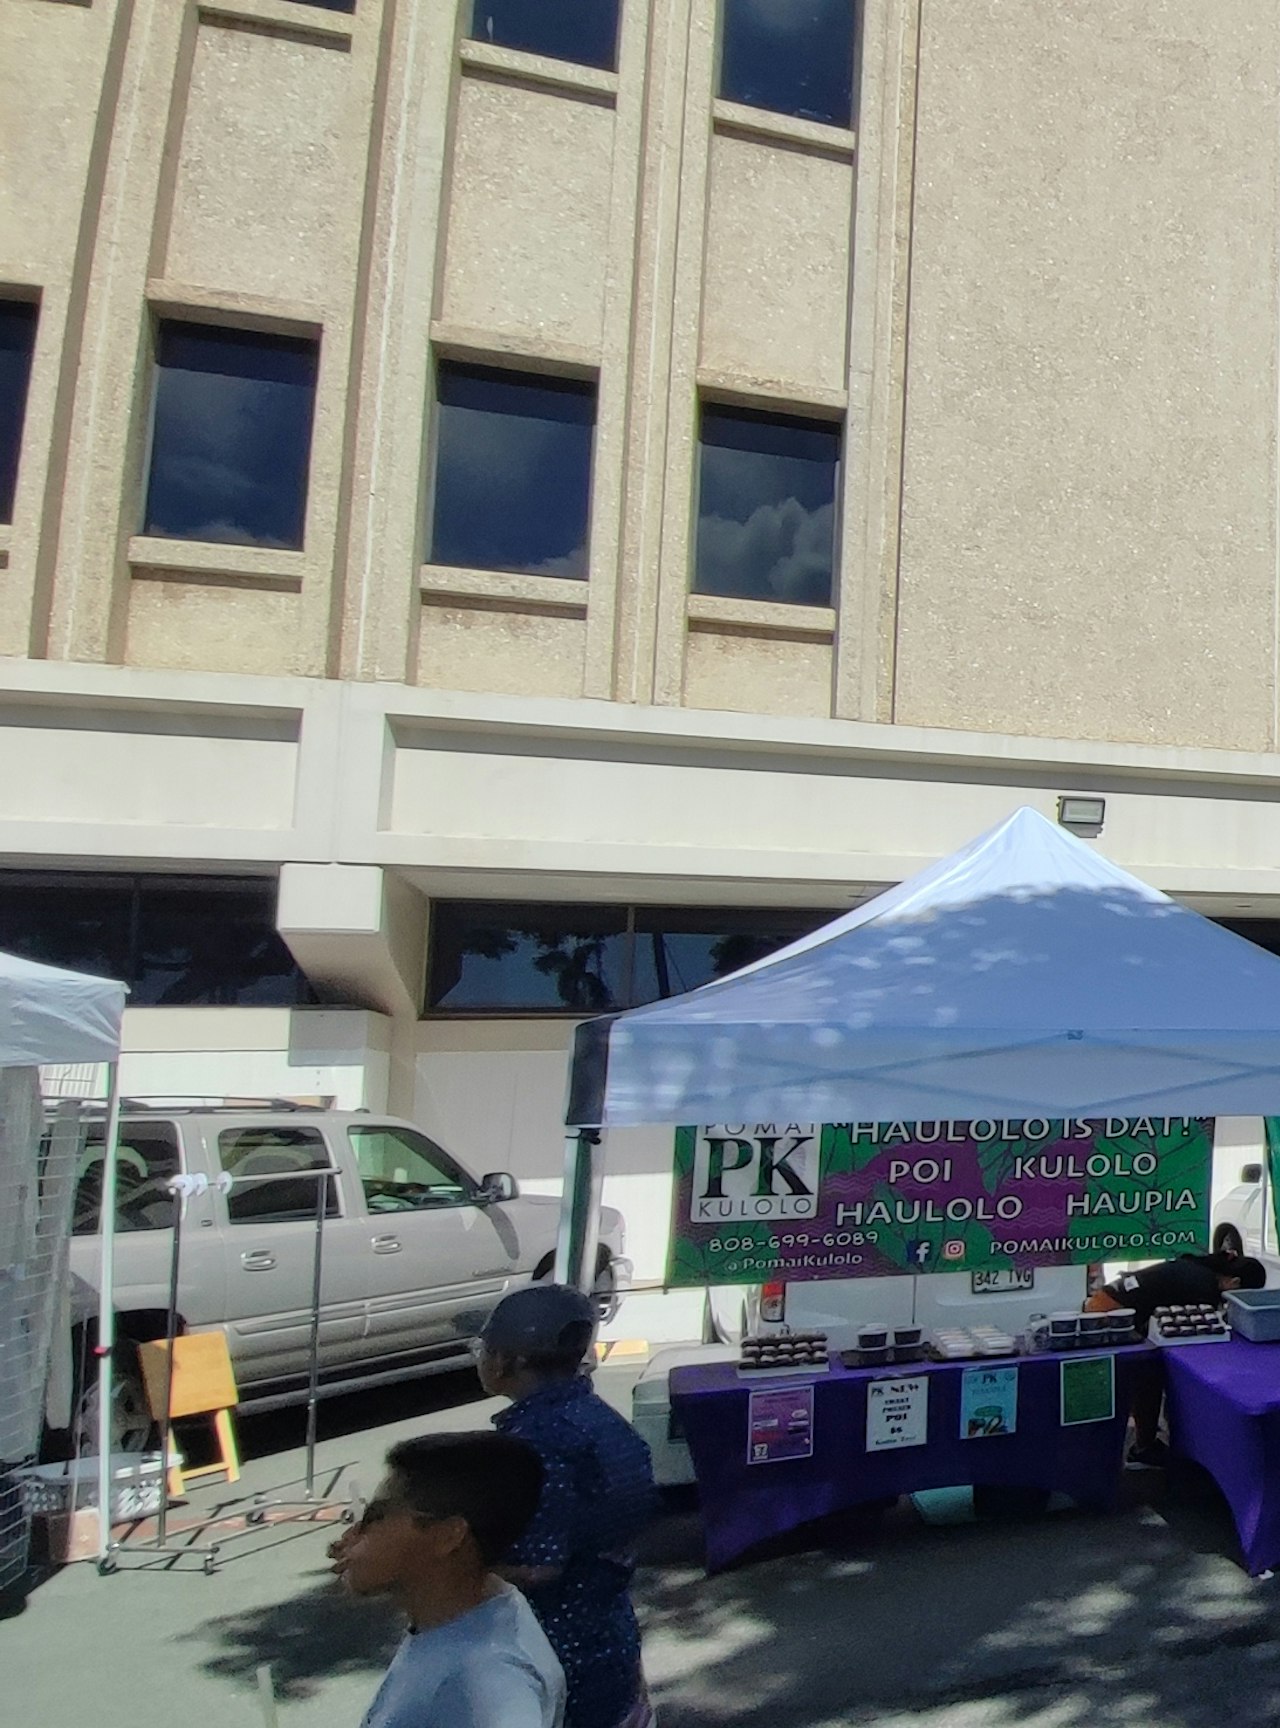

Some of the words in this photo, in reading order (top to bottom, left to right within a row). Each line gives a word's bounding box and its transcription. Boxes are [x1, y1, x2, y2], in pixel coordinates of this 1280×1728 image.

[1062, 1116, 1093, 1140] IS
[699, 1136, 815, 1198] PK
[888, 1158, 952, 1184] POI
[1014, 1152, 1157, 1179] KULOLO
[698, 1198, 812, 1218] KULOLO
[835, 1196, 1023, 1226] HAULOLO
[1066, 1189, 1197, 1216] HAUPIA
[708, 1230, 878, 1252] 808-699-6089
[990, 1230, 1195, 1255] POMAIKULOLO.COM
[974, 1269, 999, 1287] 342
